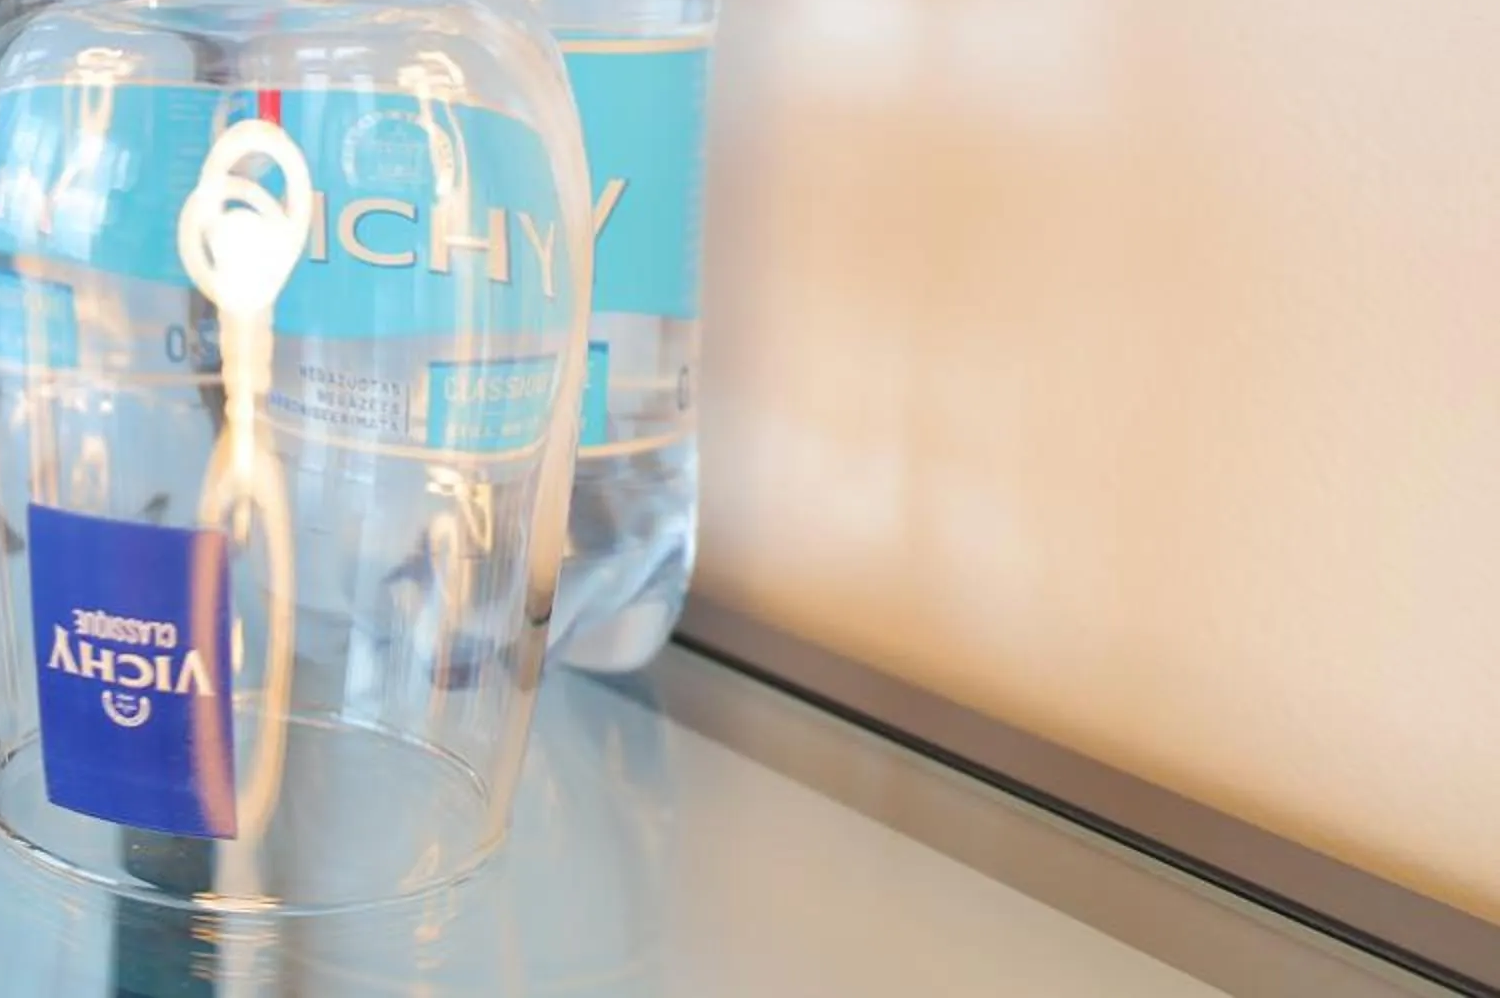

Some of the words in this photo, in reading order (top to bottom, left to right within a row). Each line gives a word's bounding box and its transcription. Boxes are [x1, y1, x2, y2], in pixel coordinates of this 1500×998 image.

[308, 189, 556, 301] ICHY
[47, 624, 216, 696] VICHY
[72, 608, 177, 649] CLASSIQUE
